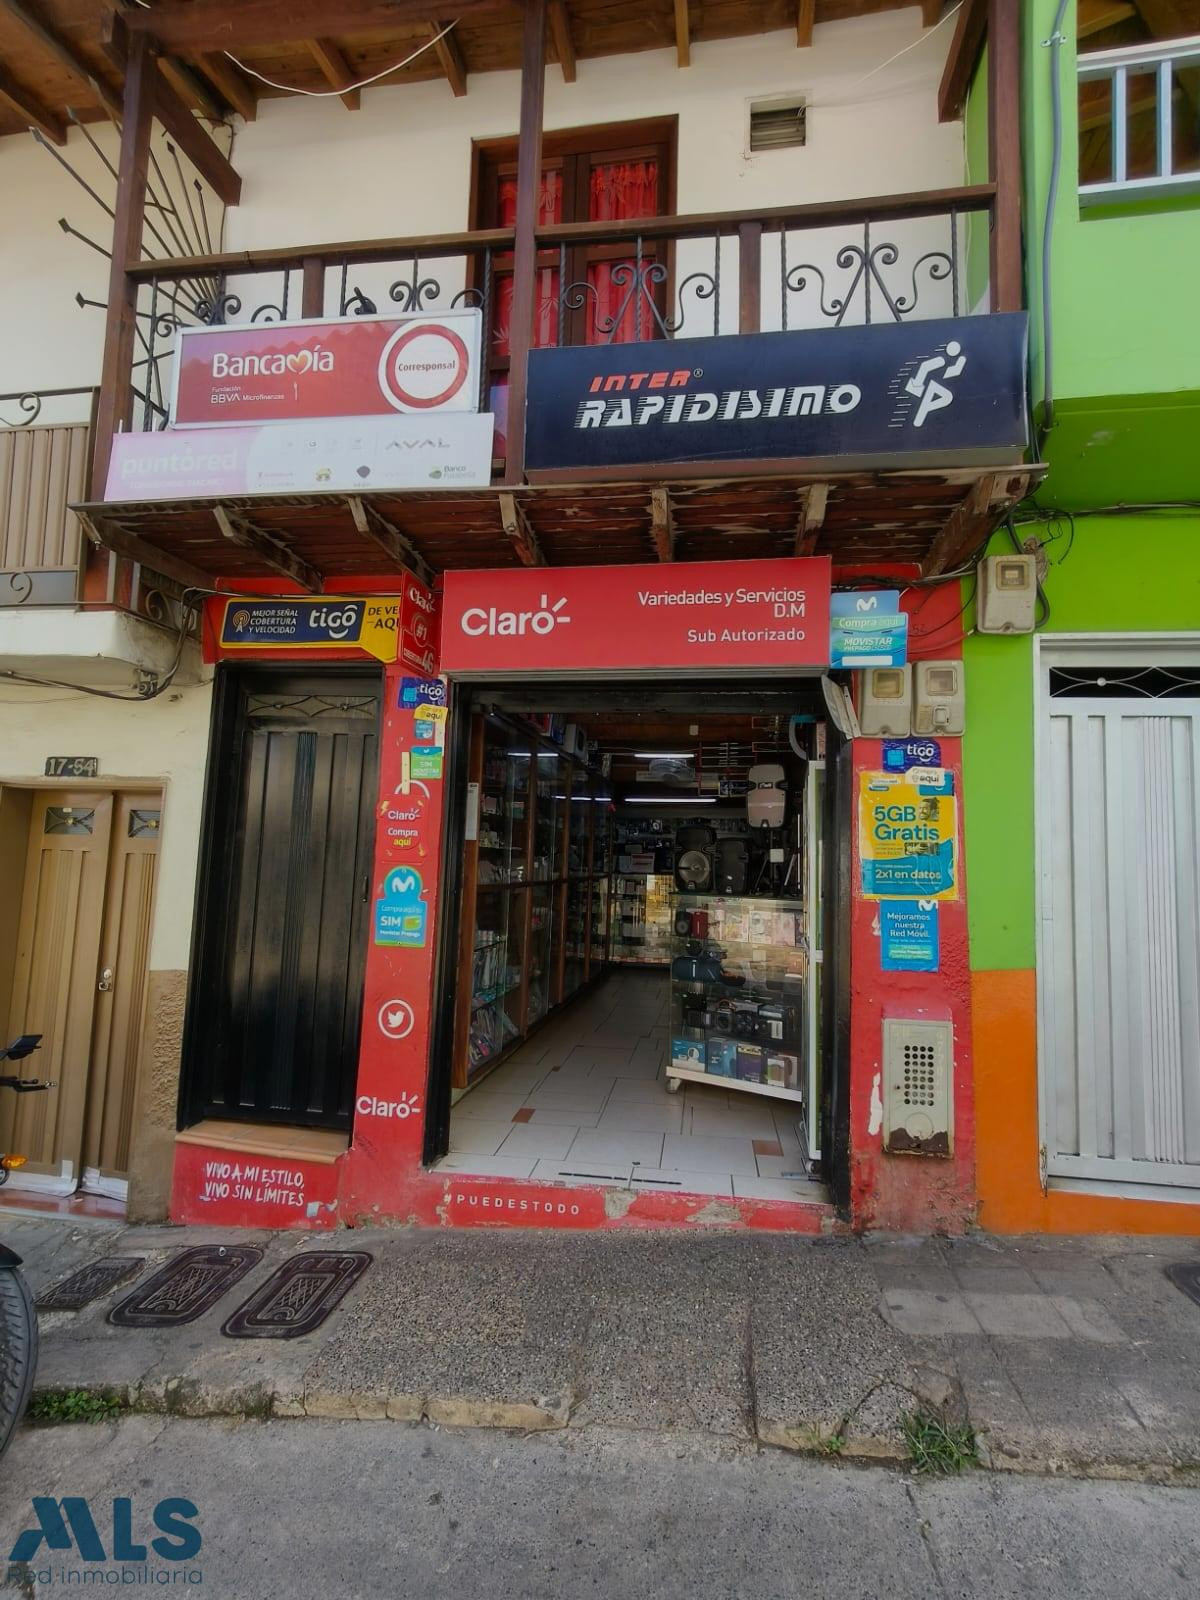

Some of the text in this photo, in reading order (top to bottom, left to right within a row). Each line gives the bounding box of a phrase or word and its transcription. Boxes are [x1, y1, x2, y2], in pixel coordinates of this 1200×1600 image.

[398, 360, 456, 373] Corresponsal
[589, 371, 691, 392] INTER
[212, 385, 241, 393] Fundación
[210, 393, 285, 404] BBVA Microfinanzas
[574, 384, 862, 428] RAPIDISIMO
[443, 464, 467, 473] Banco
[638, 587, 806, 606] Variedades y Servicios
[277, 608, 299, 617] SEÑAL
[368, 606, 400, 616] DE VE
[773, 602, 806, 618] D.M
[250, 617, 298, 626] COBERTURA
[309, 604, 358, 630] tigo
[461, 599, 561, 636] Claro
[254, 626, 296, 634] VELOCIDAD
[839, 618, 877, 630] Compra
[687, 627, 806, 643] Sub Autorizado
[844, 637, 893, 647] MOVISTAR
[419, 684, 443, 698] tigo
[906, 744, 935, 758] tigo
[387, 809, 418, 821] Claro
[874, 805, 916, 822] 5GB
[387, 827, 419, 838] Compra
[874, 823, 940, 841] Gratis
[875, 869, 941, 880] 2x1 en datos
[380, 915, 402, 927] SIM
[886, 911, 930, 922] Mejoramos
[894, 921, 925, 929] nuestra
[889, 929, 906, 937] Red
[356, 1093, 416, 1118] Claro
[206, 1161, 305, 1189] VIVO A MI ESTILO,
[205, 1181, 304, 1207] VIVO SIN LÍMITES
